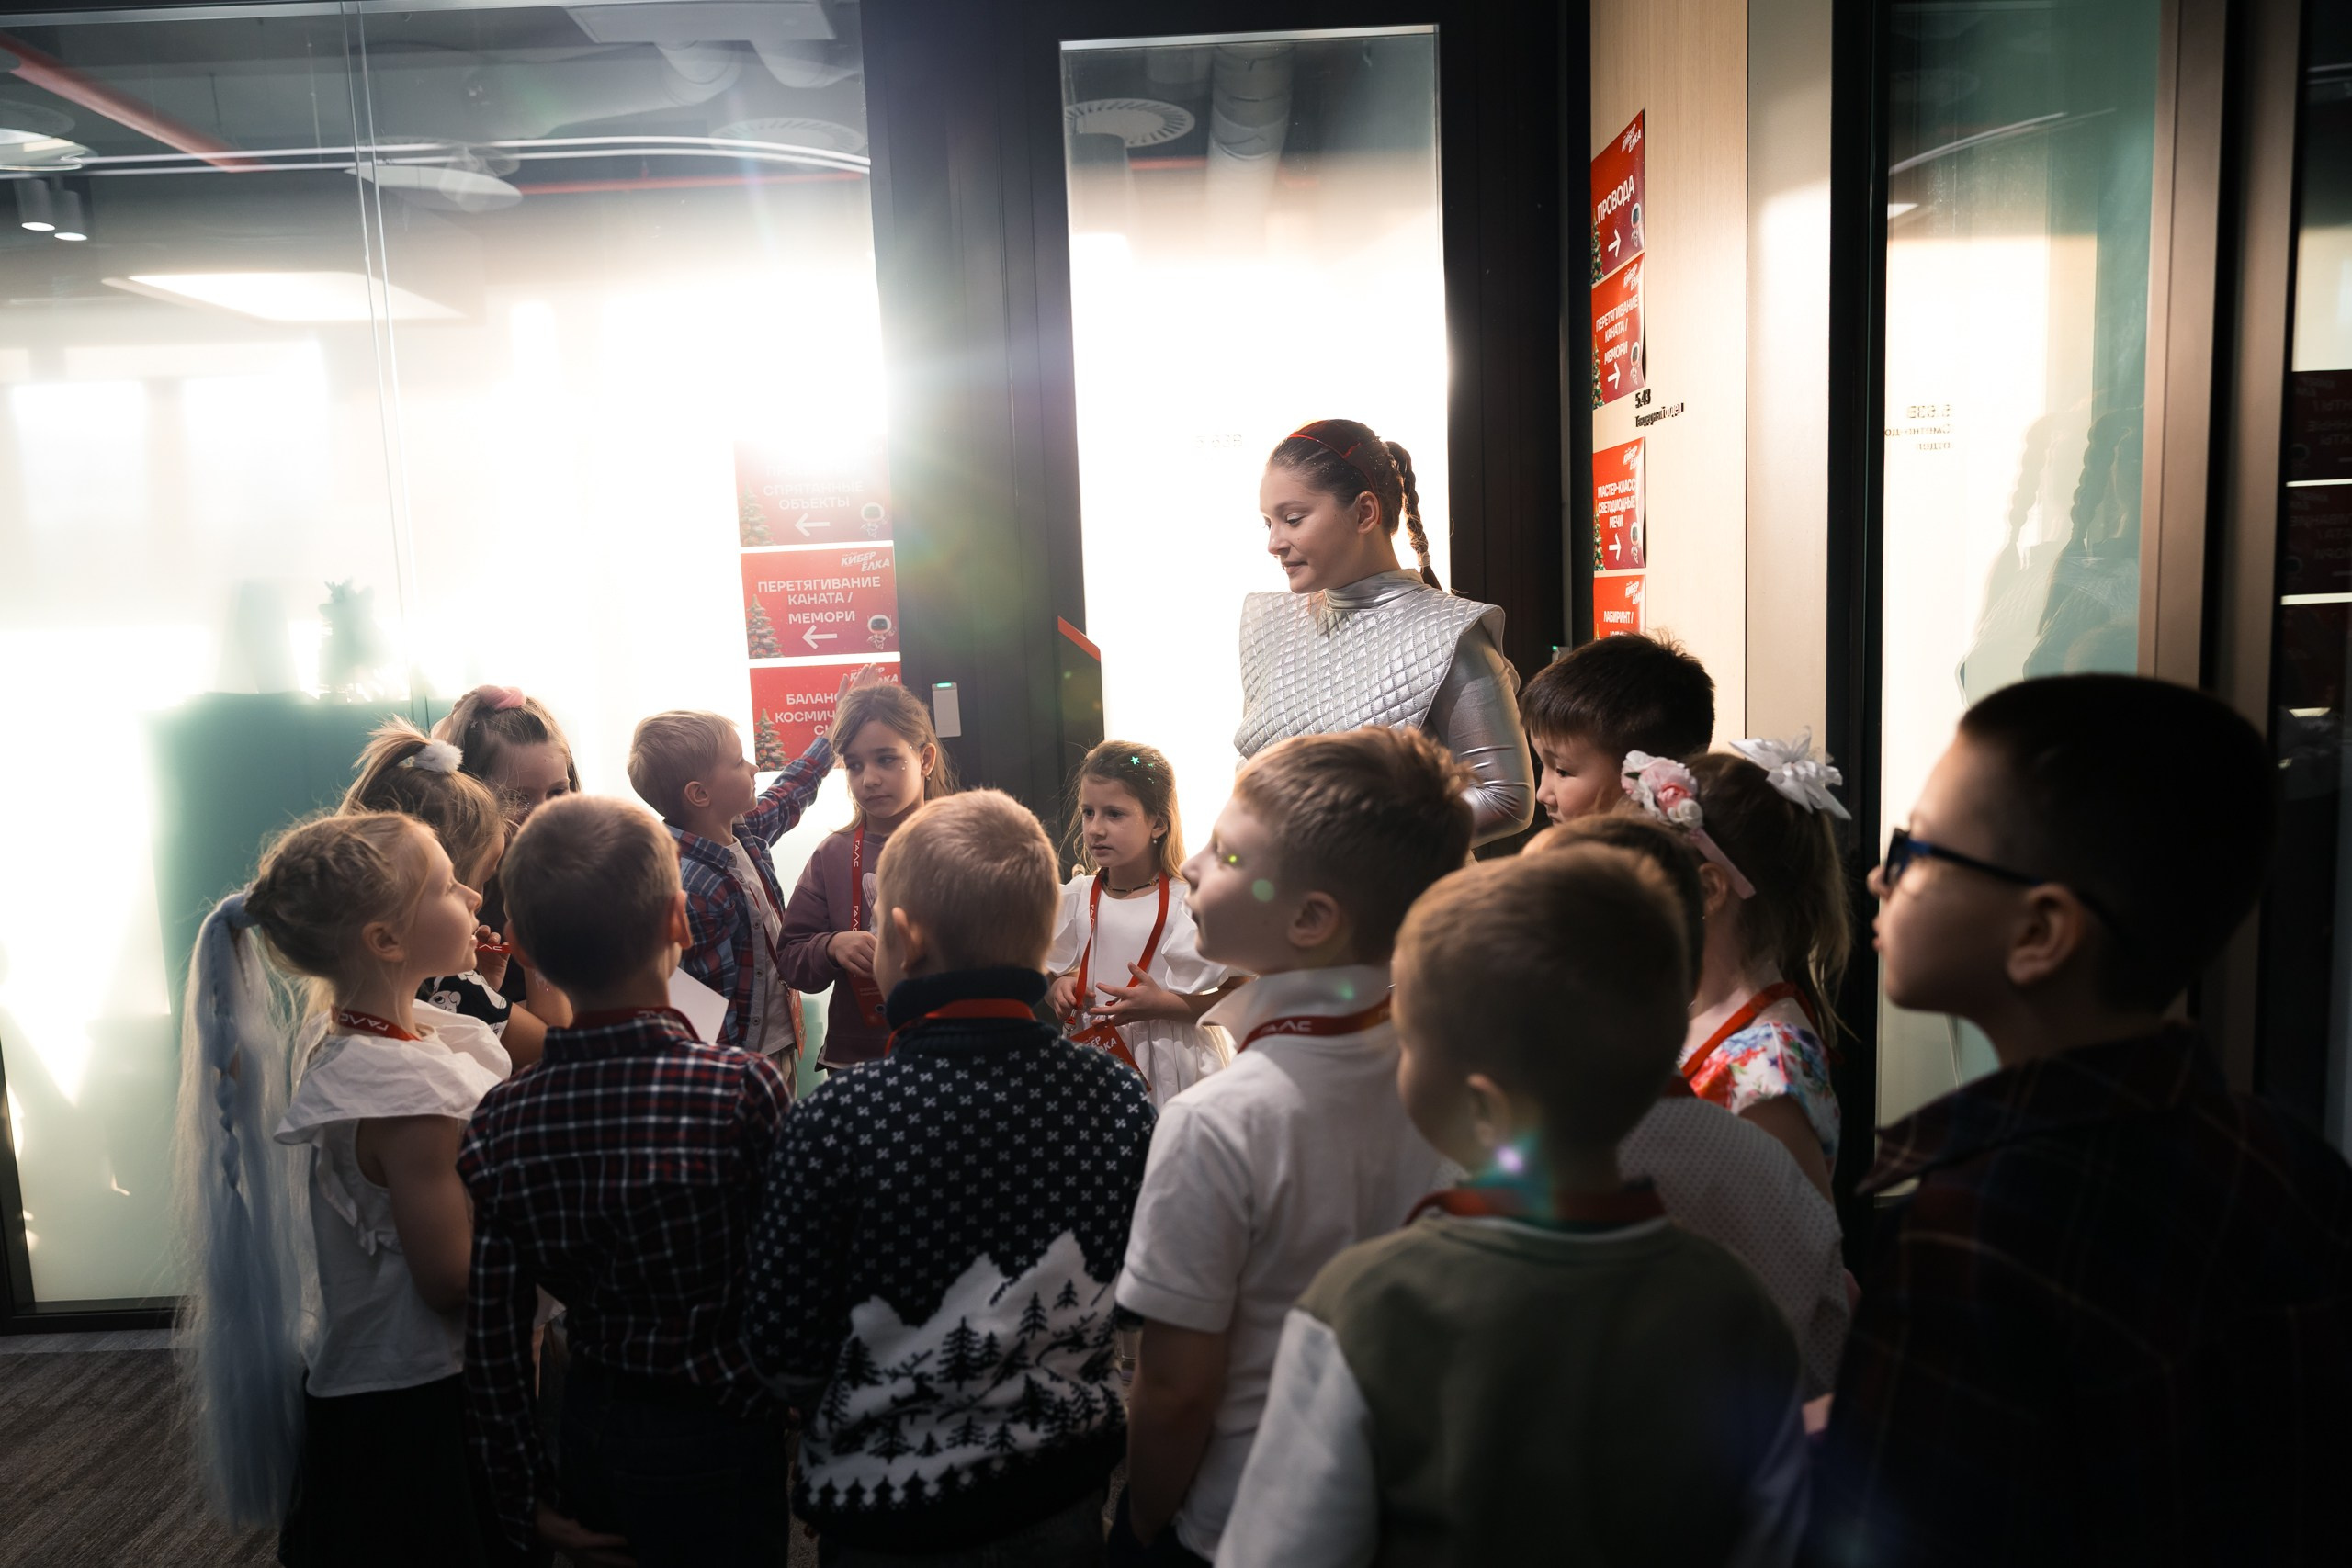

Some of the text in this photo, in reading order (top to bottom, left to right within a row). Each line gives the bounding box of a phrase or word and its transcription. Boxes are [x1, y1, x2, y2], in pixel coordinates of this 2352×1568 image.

[1597, 175, 1635, 223] ПРОВОДА
[1596, 294, 1638, 333] ПЕРЕТЯГИВАНИЕ
[1605, 320, 1625, 343] КАНАТА
[1604, 341, 1628, 365] МЕМОРИ
[763, 480, 865, 497] СПРЯТАННЫЕ
[1597, 478, 1636, 498] МАСТЕР-КЛАСС
[778, 496, 851, 510] ОБЪЕКТЫ
[1598, 495, 1636, 514] СВЕТОДИОДНЫЕ
[1609, 514, 1623, 528] МЕЧИ
[841, 551, 876, 567] КИБЕР
[861, 558, 890, 572] ЁЛКА
[757, 576, 881, 593] ПЕРЕТЯГИВАНИЕ
[787, 592, 844, 606] КАНАТА
[787, 610, 855, 626] МЕМОРИ
[1603, 610, 1631, 624] ЛАБИРИНТ
